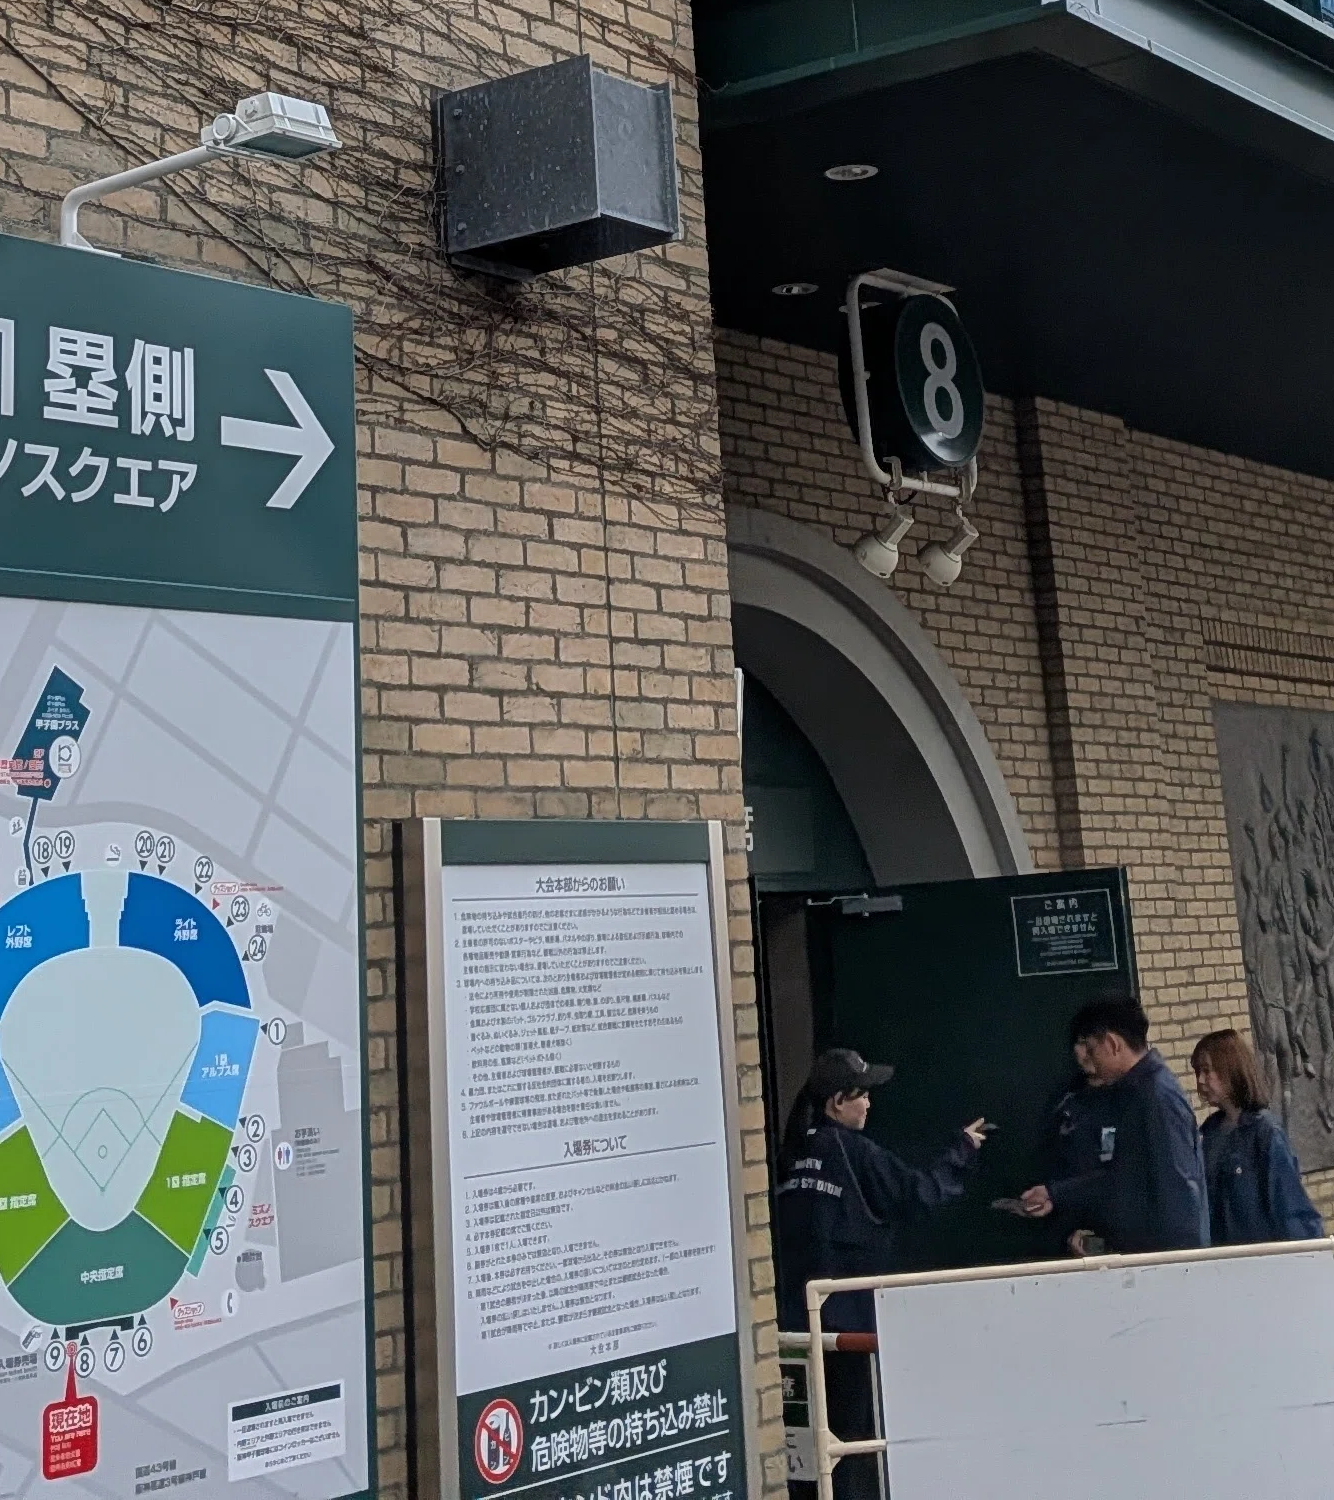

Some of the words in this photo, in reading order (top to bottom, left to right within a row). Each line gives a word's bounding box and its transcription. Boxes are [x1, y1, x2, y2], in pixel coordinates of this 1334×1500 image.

[919, 322, 965, 439] 8
[563, 1134, 628, 1159] 入場券について
[50, 1403, 93, 1433] 現在地
[529, 1358, 667, 1425] カン・ビン類及び
[530, 1388, 730, 1473] 危険物等の持ち込み禁止
[560, 1450, 732, 1500] ド内は禁煙です
